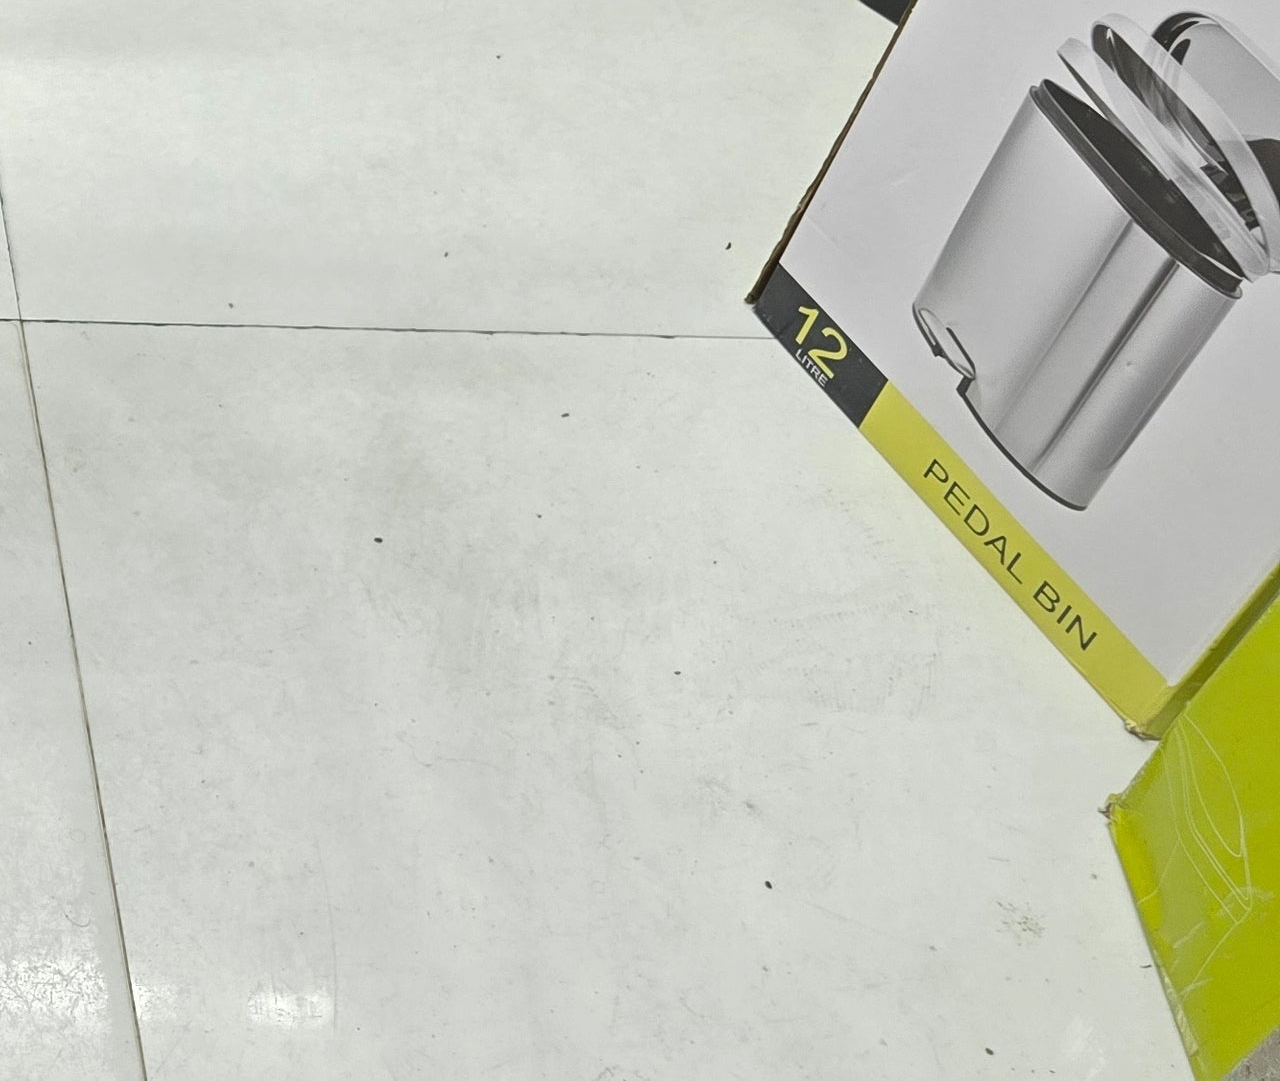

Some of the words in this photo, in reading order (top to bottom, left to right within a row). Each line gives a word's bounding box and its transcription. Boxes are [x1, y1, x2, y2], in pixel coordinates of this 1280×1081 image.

[795, 306, 848, 379] 12
[795, 348, 828, 388] LITRE
[922, 459, 1024, 584] PEDAL
[1032, 580, 1098, 651] BIN
